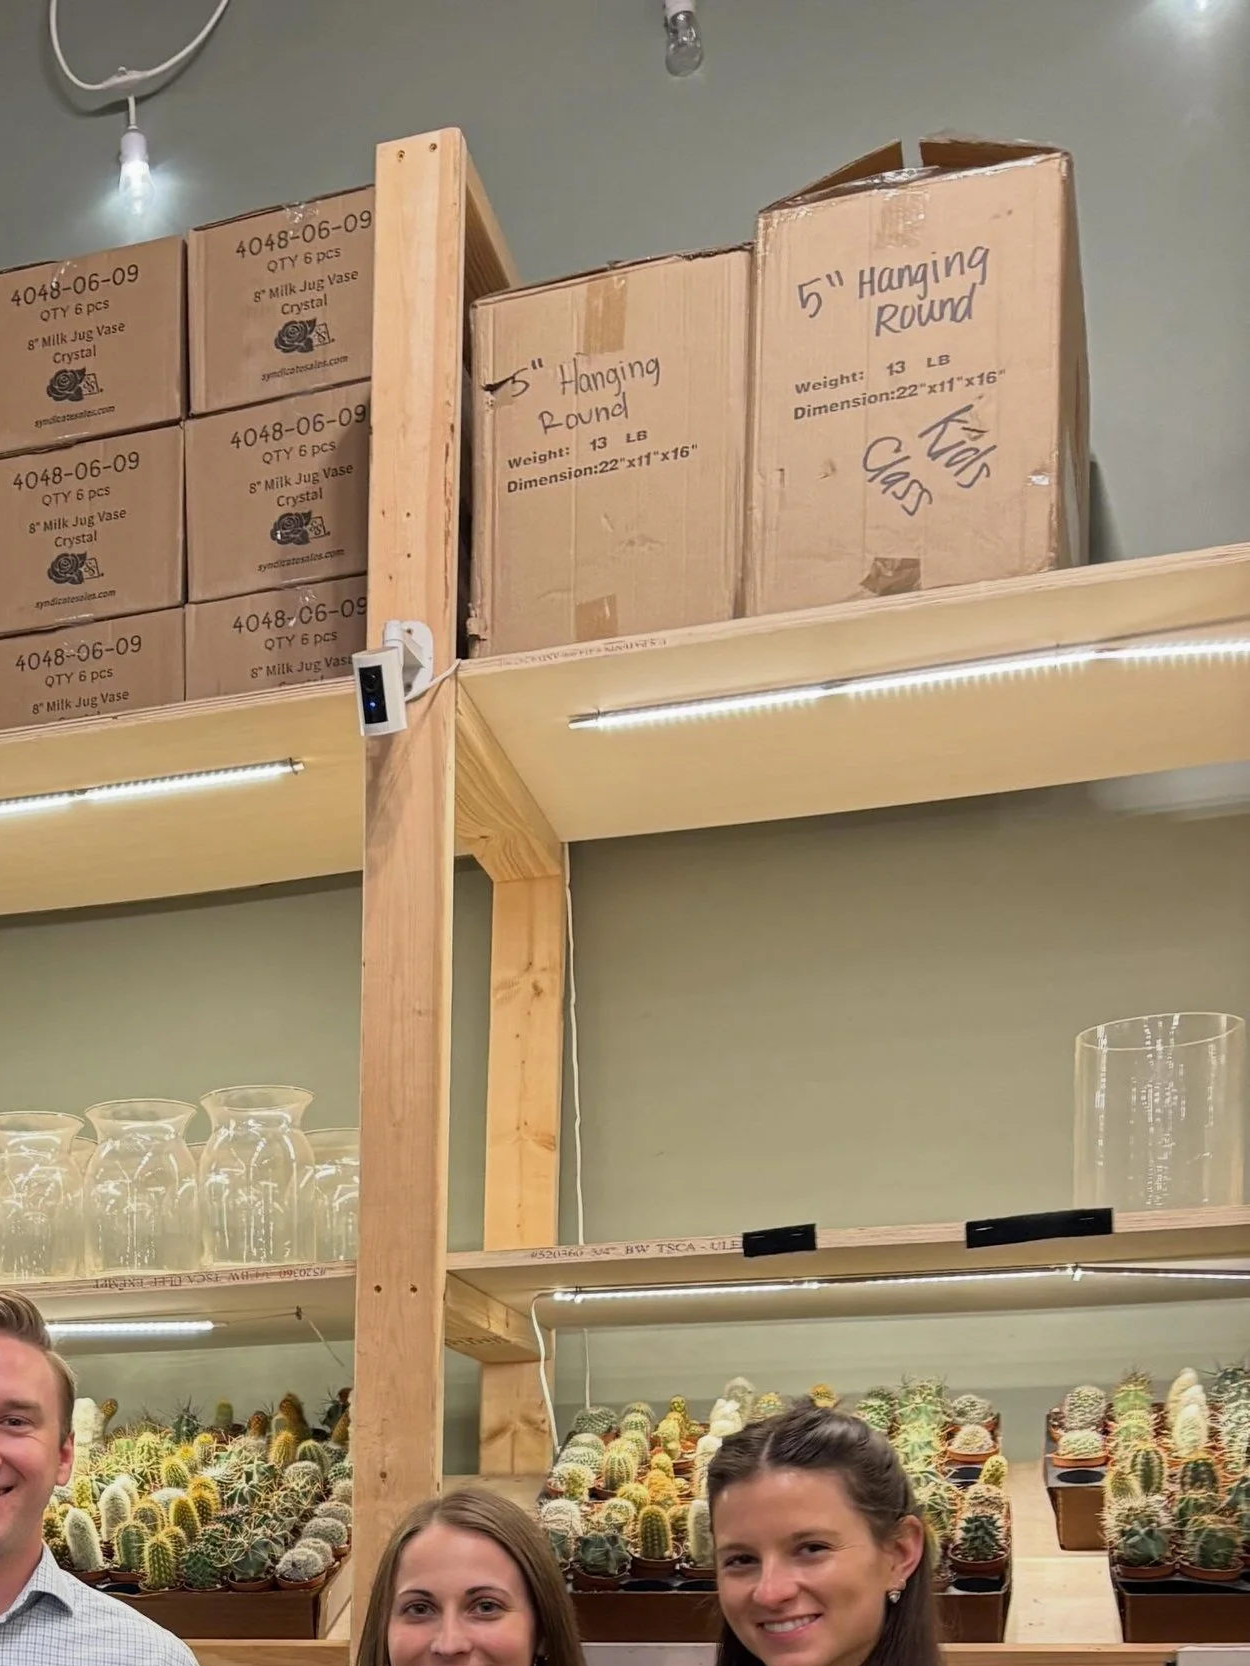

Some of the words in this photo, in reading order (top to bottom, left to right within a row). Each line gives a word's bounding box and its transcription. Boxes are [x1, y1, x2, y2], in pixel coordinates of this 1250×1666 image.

[236, 210, 372, 258] 4048-06-09
[267, 255, 298, 273] QTY
[304, 252, 312, 264] 6
[316, 247, 341, 264] pcs
[11, 266, 139, 307] 4048-06-09
[269, 283, 296, 299] Milk
[299, 279, 324, 295] Jug
[327, 270, 358, 285] Vase
[797, 270, 844, 318] 5"
[857, 245, 990, 300] Hanging
[40, 305, 70, 322] QTY
[86, 299, 109, 314] pcs
[281, 294, 327, 315] Crystal
[875, 282, 977, 337] Round
[41, 334, 68, 347] Milk
[71, 329, 93, 344] Jug
[96, 322, 125, 336] Vase
[53, 345, 97, 365] Crystal
[559, 356, 660, 397] Hanging
[794, 371, 865, 395] Weight:
[886, 360, 906, 377] 13
[926, 354, 951, 369] LB
[230, 404, 366, 449] 4048-06-09
[538, 392, 629, 435] Round
[262, 447, 293, 465] QTY
[299, 444, 307, 458] 6
[311, 440, 336, 457] pcs
[507, 446, 570, 470] Weight:
[589, 436, 607, 451] 13
[625, 430, 648, 443] LB
[12, 451, 139, 491] 4048-06-09
[264, 475, 292, 490] Milk
[295, 471, 319, 486] Jug
[322, 464, 353, 479] Vase
[862, 436, 933, 517] Class
[42, 492, 71, 506] QTY
[76, 489, 84, 500] 6
[87, 485, 110, 500] pcs
[277, 488, 323, 507] Crystal
[43, 517, 69, 532] Milk
[72, 514, 95, 530] Jug
[97, 508, 127, 522] Vase
[54, 531, 97, 550] Crystal
[233, 597, 367, 634] 4048-06-09
[15, 635, 142, 672] 4048-06-09
[264, 635, 295, 651] QTY
[301, 634, 309, 646] 6
[313, 630, 338, 646] pcs
[45, 673, 73, 688] QTY
[79, 670, 86, 682] 6
[90, 667, 113, 683] pcs
[266, 662, 293, 675] Milk
[296, 659, 321, 673] Jug
[47, 698, 72, 712] Milk
[75, 695, 98, 710] Jug
[101, 690, 129, 703] Vase
[658, 1242, 695, 1254] TSCA
